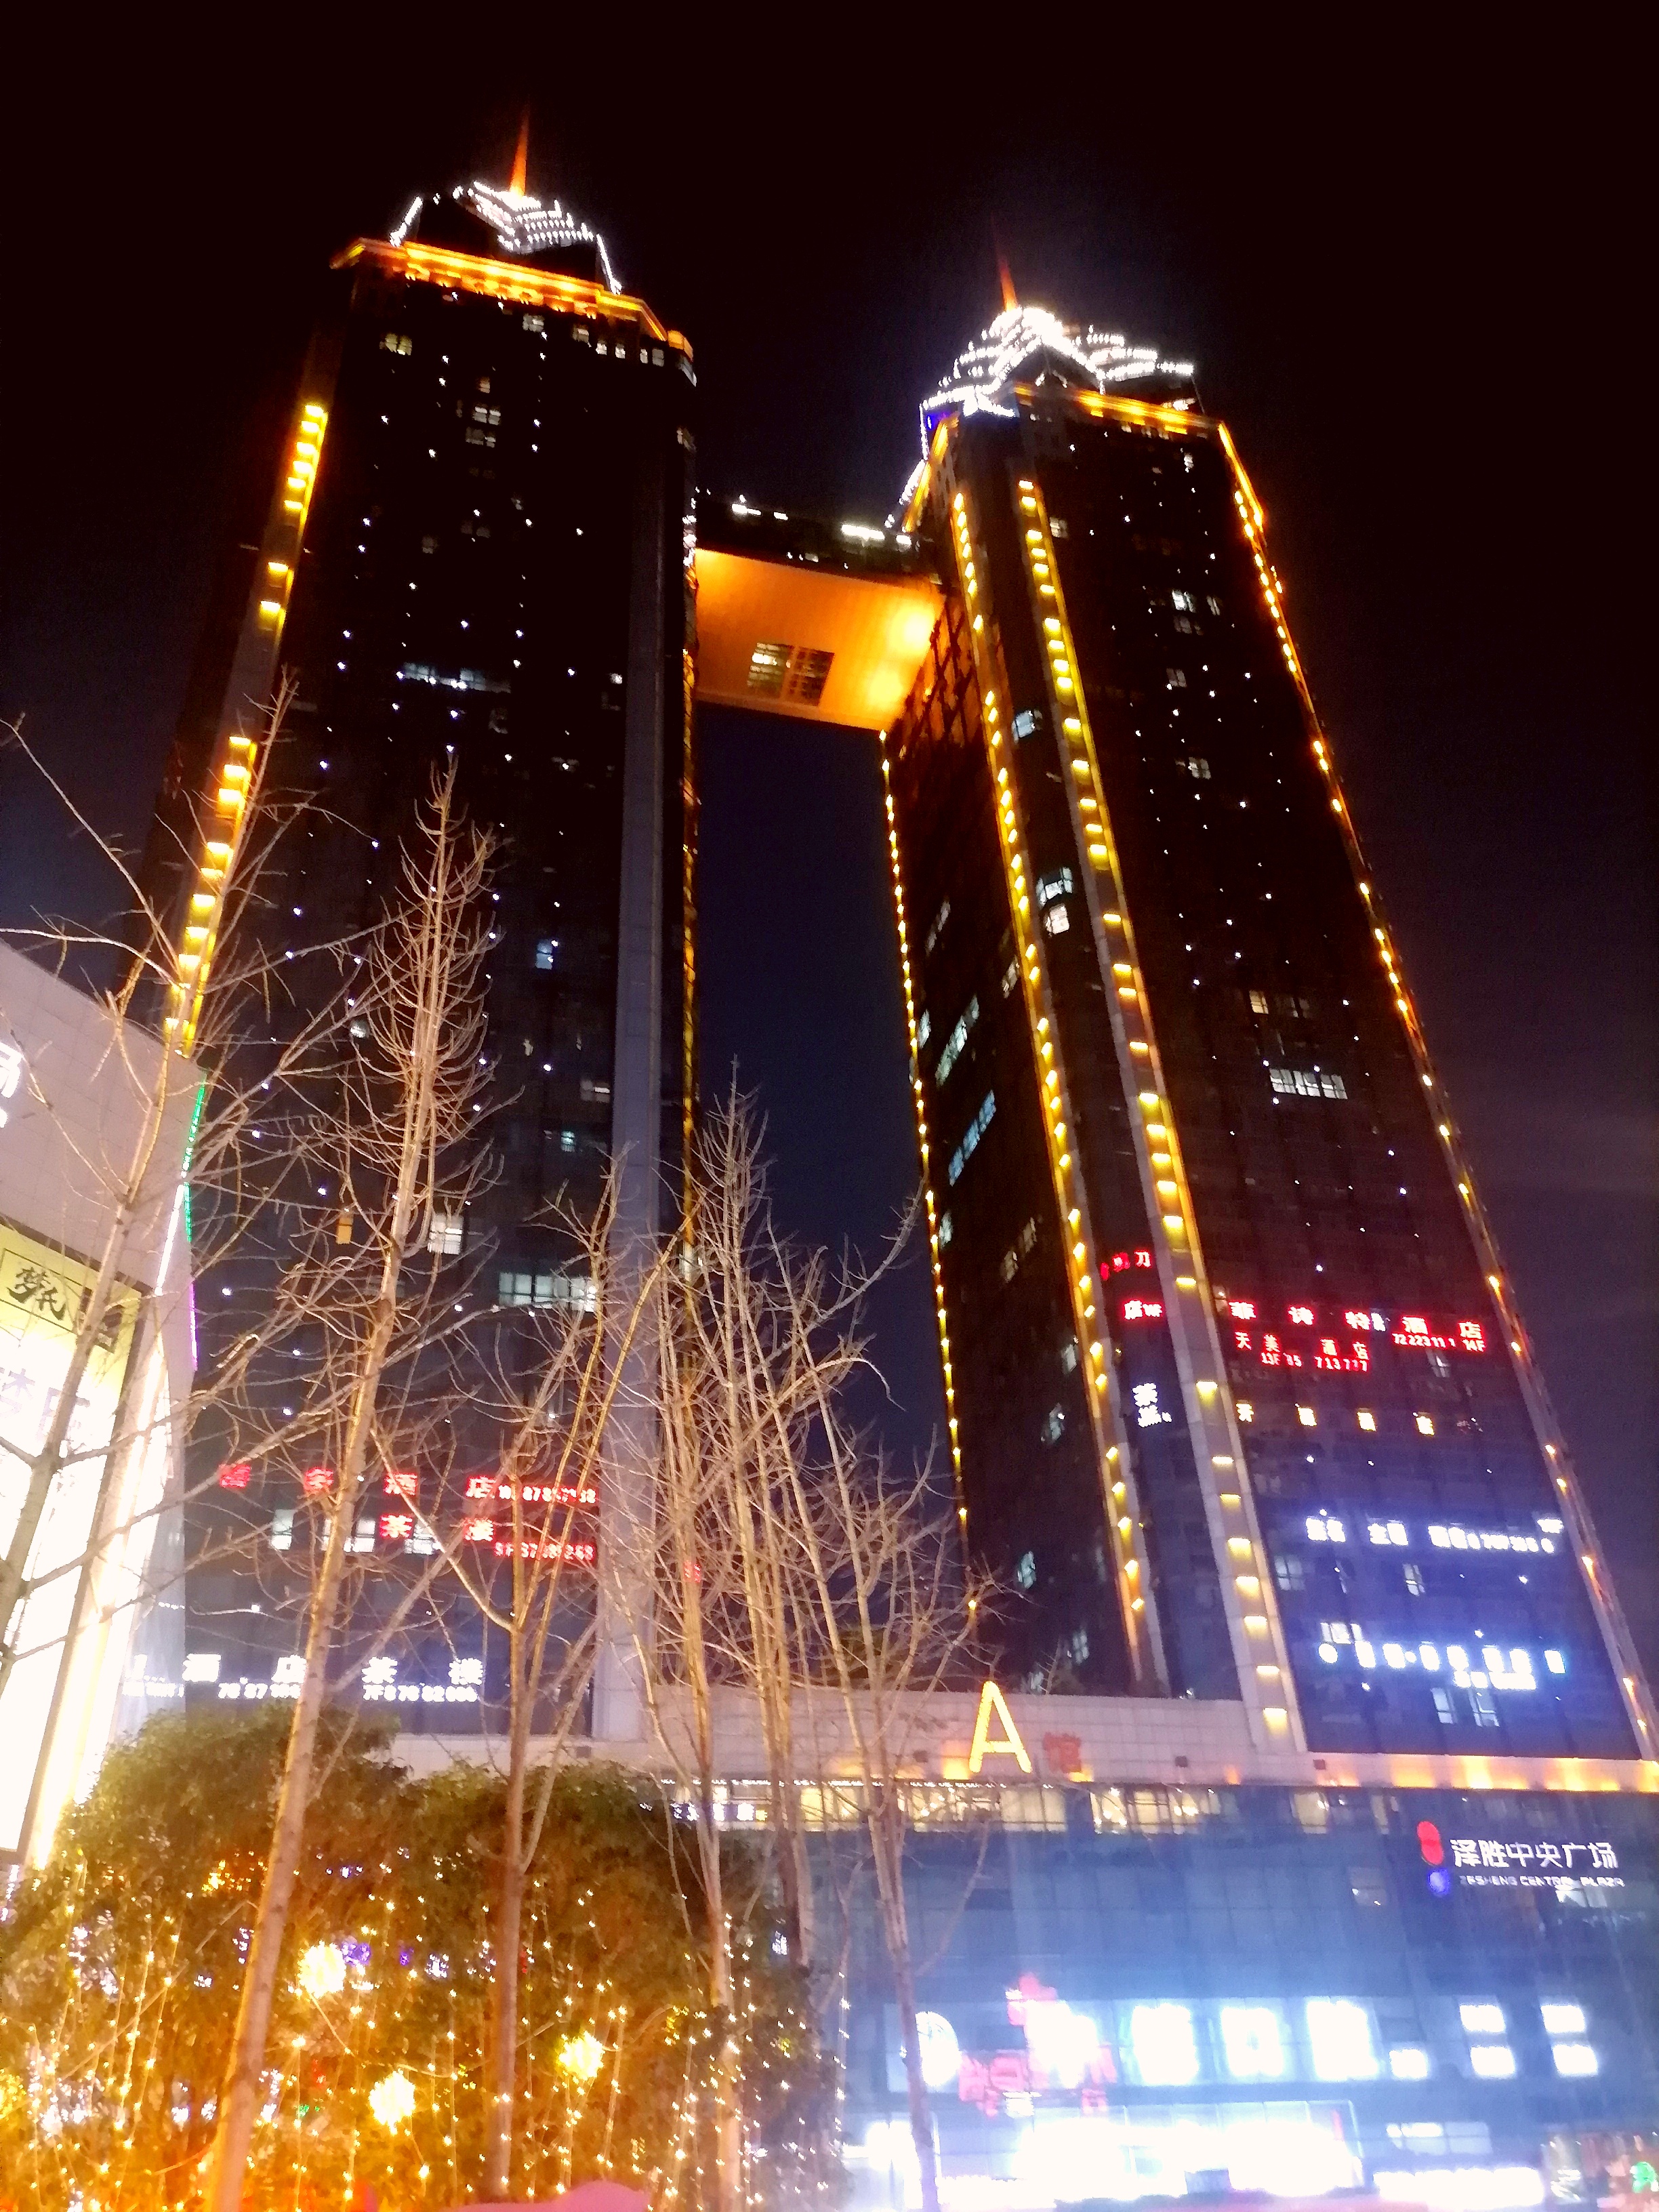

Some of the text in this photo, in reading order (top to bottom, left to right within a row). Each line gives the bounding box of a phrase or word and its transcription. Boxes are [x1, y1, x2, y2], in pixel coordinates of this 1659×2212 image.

[968, 1679, 1033, 1774] A
[1450, 1839, 1618, 1869] 泽胜中央广场
